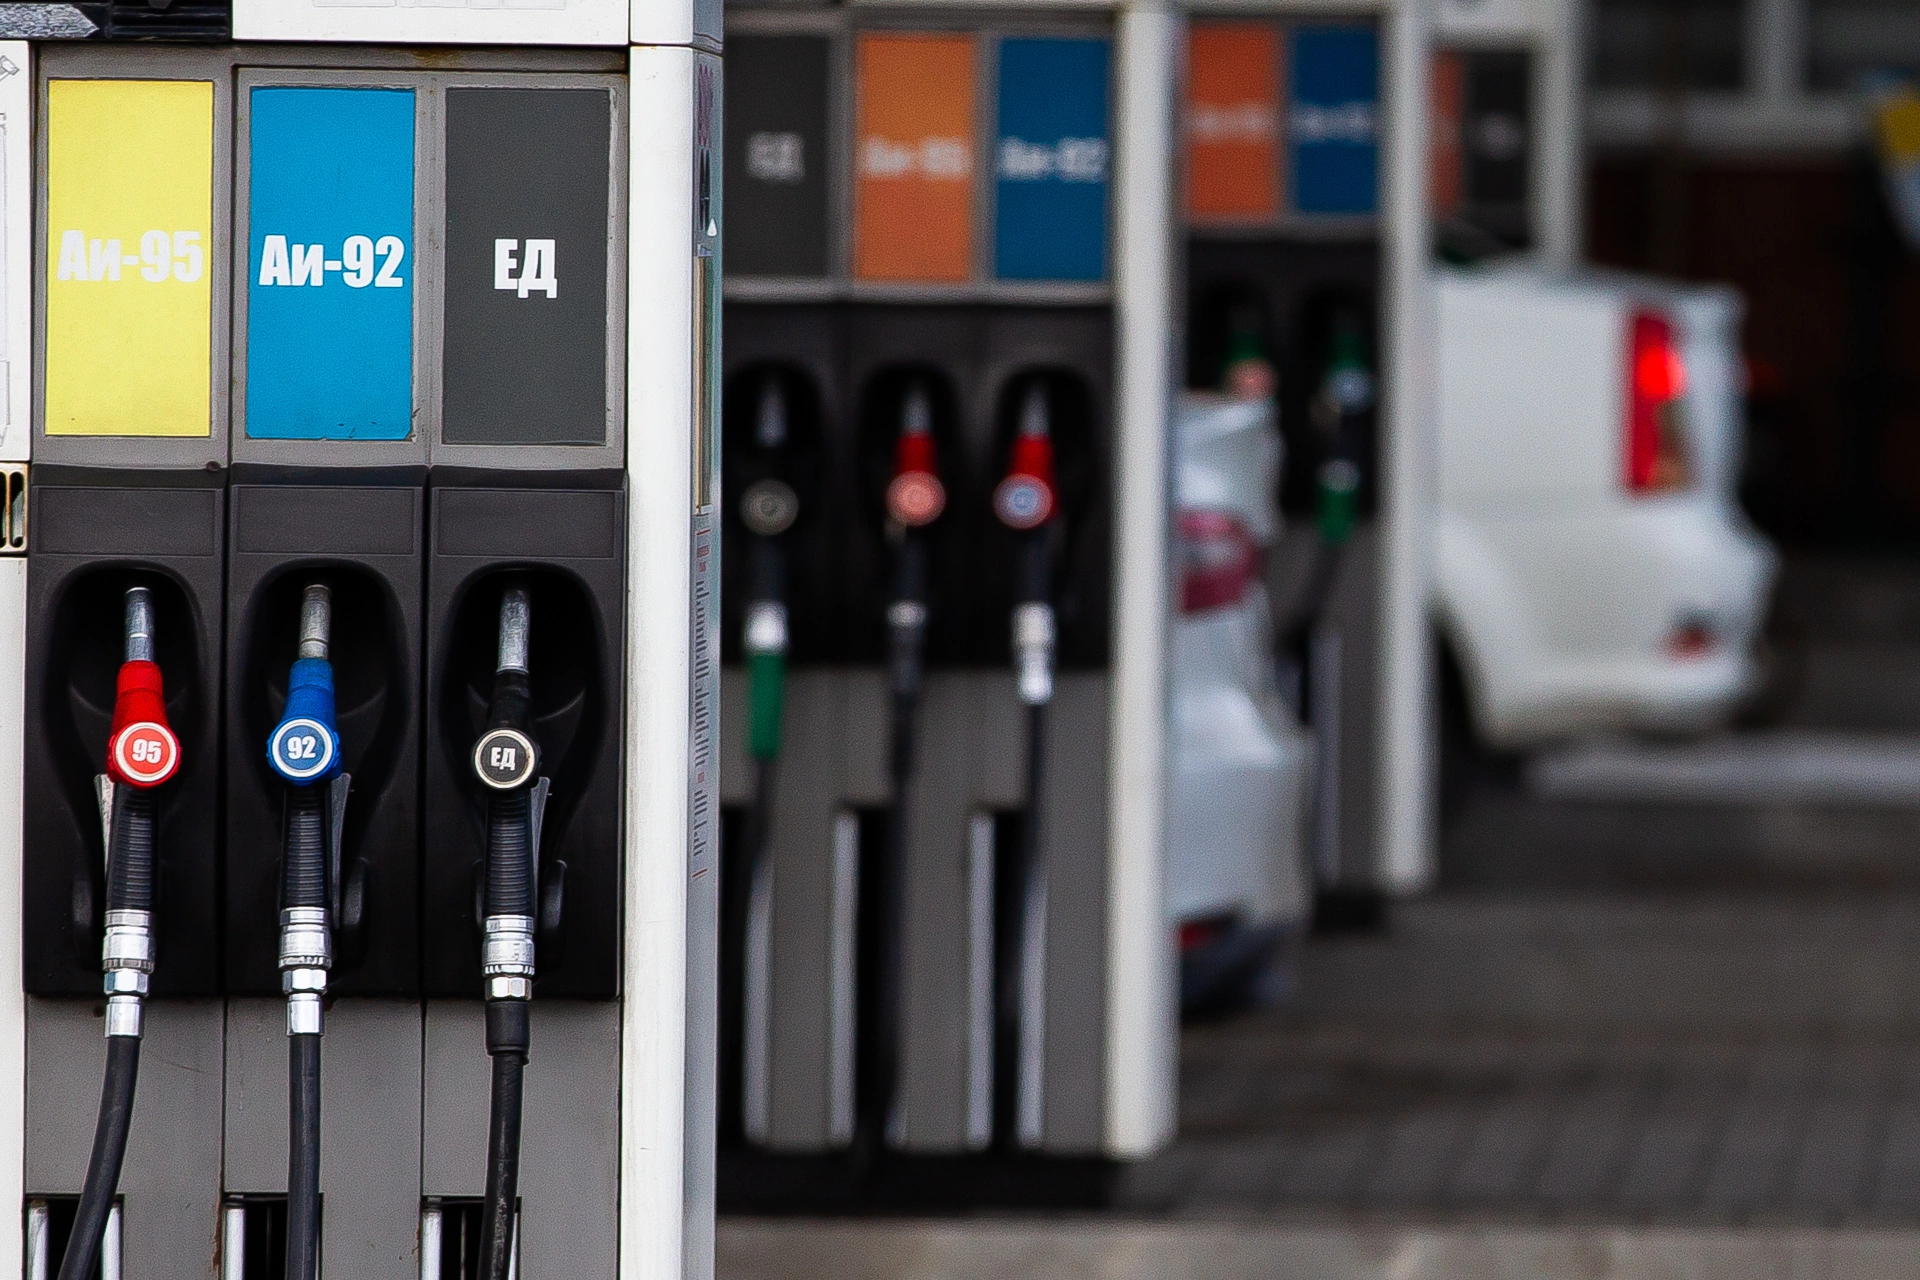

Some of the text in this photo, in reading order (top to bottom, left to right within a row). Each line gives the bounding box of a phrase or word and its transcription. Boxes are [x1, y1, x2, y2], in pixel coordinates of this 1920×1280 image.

[57, 230, 204, 283] Аи-95
[259, 235, 405, 288] Аи-92
[494, 238, 558, 299] ЕД
[131, 738, 162, 764] 95
[287, 735, 316, 760] 92
[490, 746, 516, 771] ЕД
